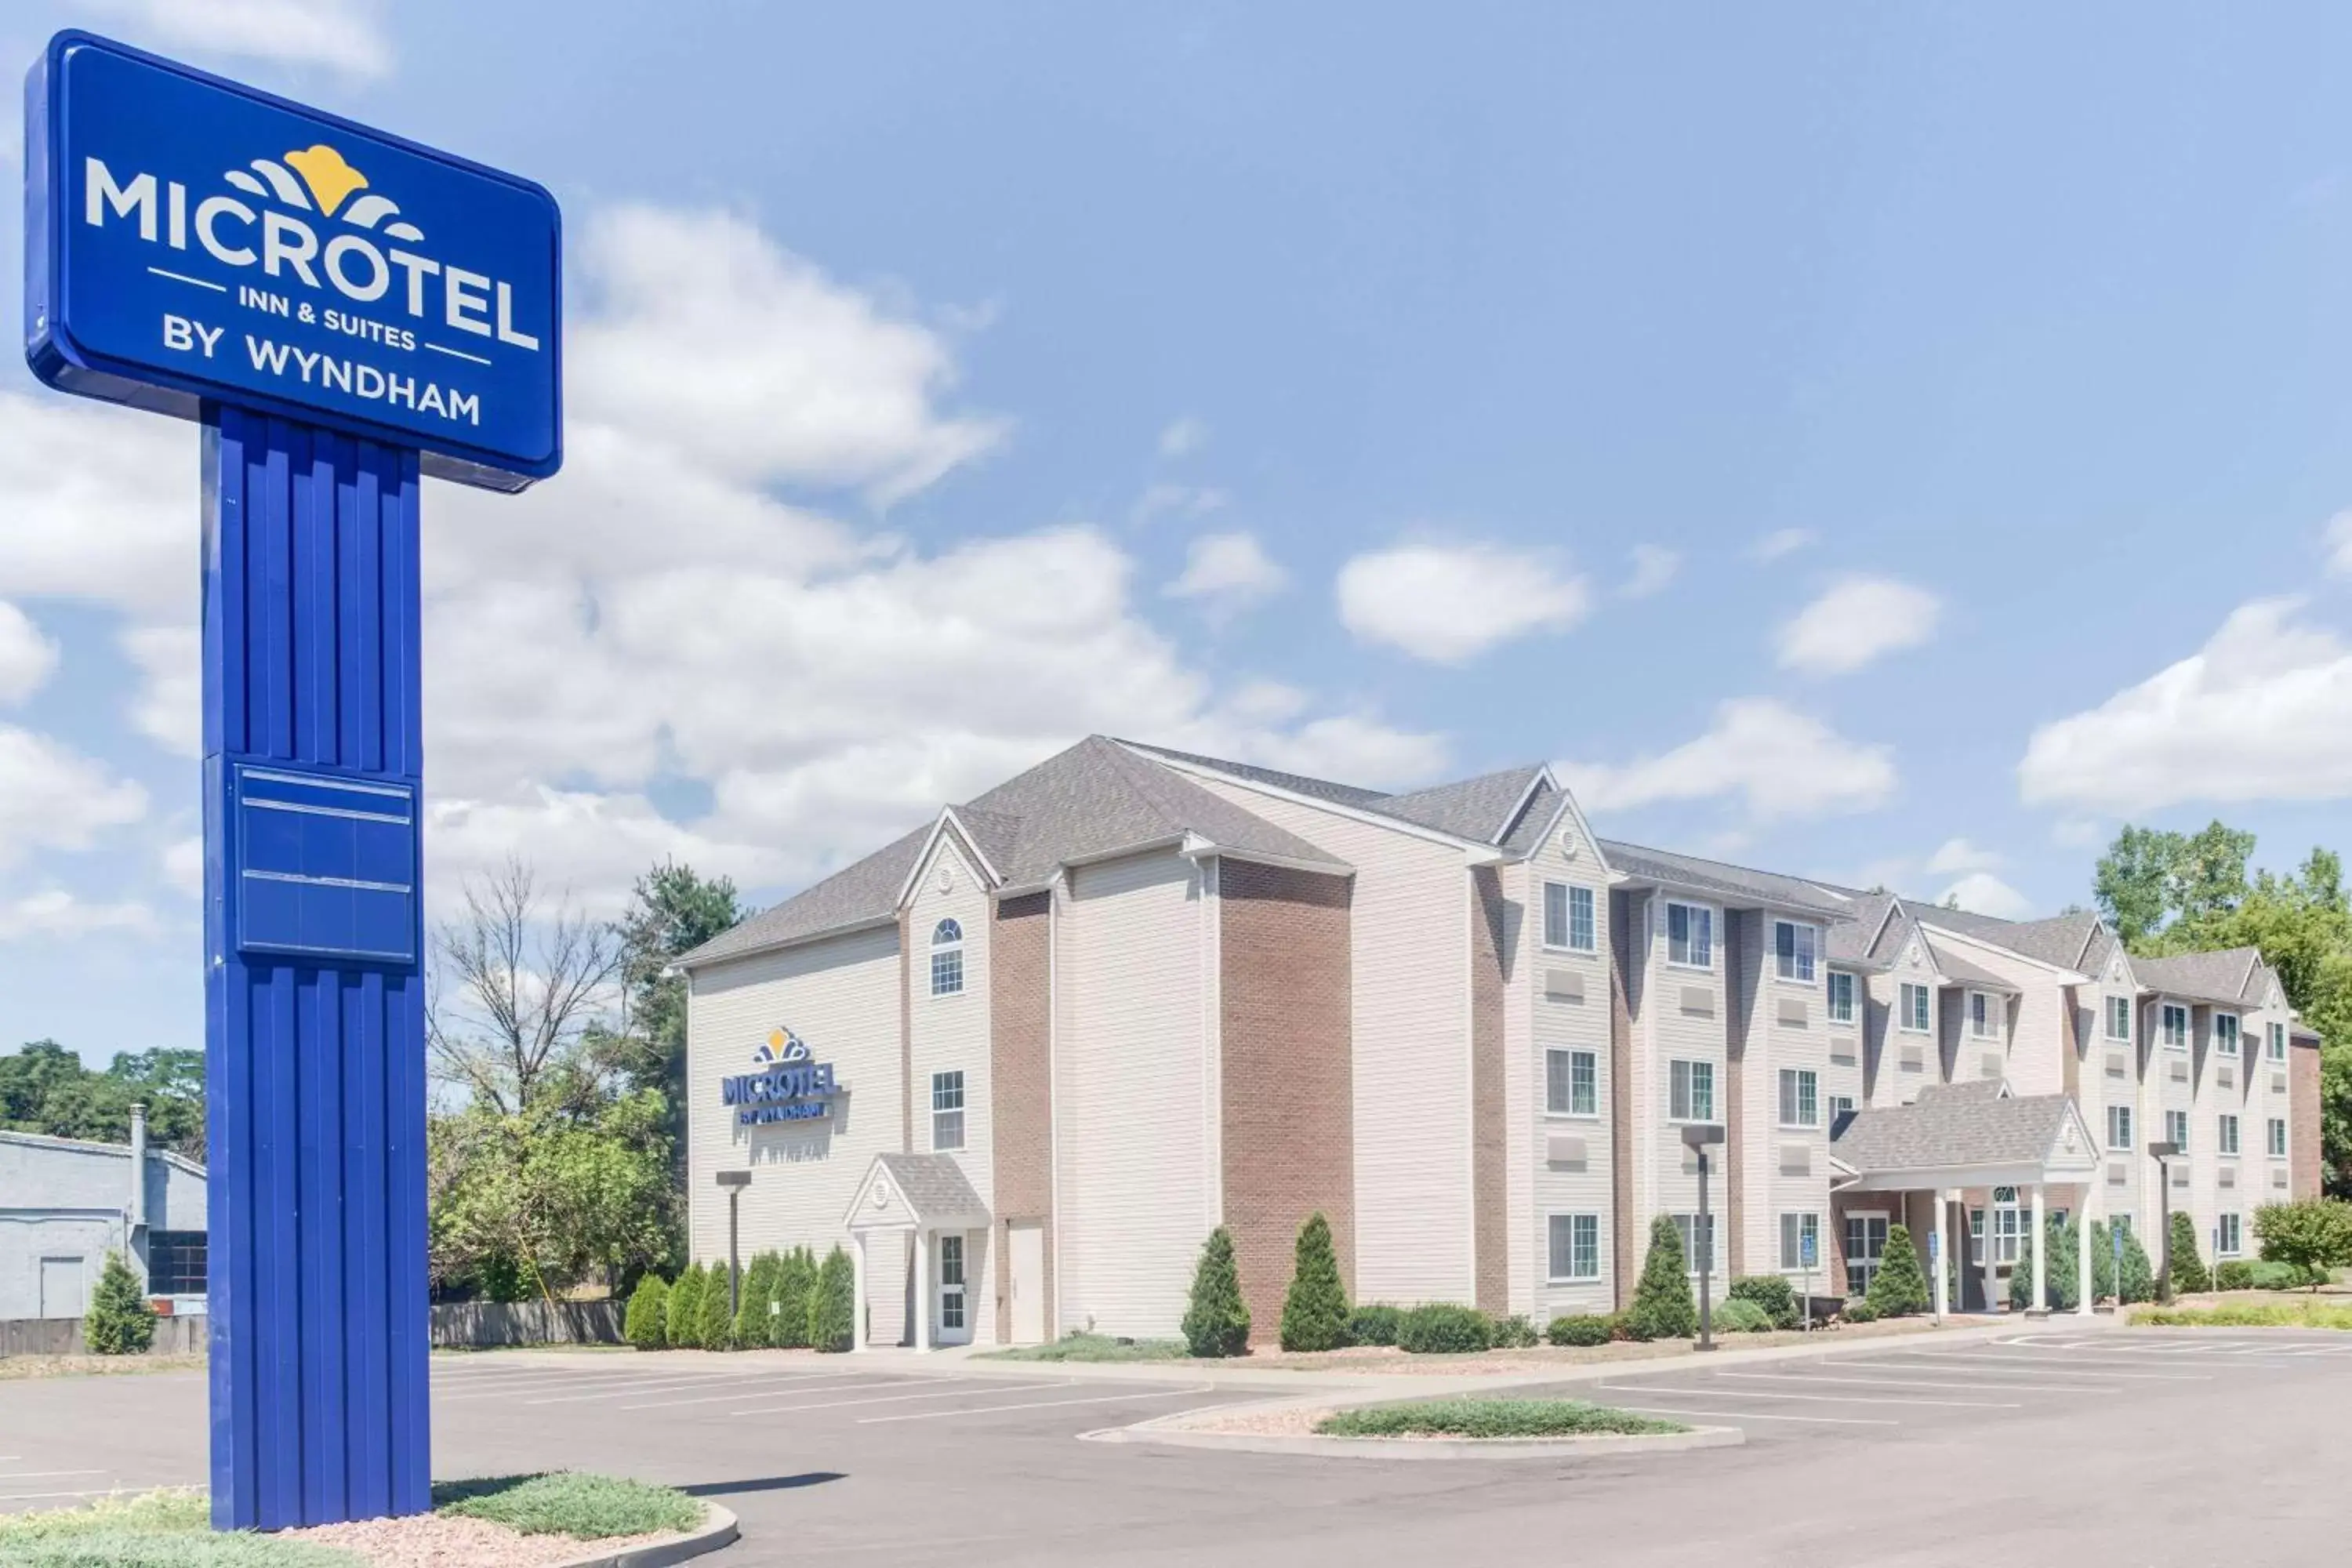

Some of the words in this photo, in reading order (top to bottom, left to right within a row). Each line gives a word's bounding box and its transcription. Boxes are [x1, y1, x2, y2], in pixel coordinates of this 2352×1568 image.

[85, 156, 539, 351] MICROTEL
[239, 285, 289, 318] INN
[297, 302, 316, 324] &
[324, 309, 416, 351] SUITES
[164, 313, 224, 358] BY
[245, 335, 480, 426] WYNDHAM
[722, 1062, 837, 1106] MICROTEL
